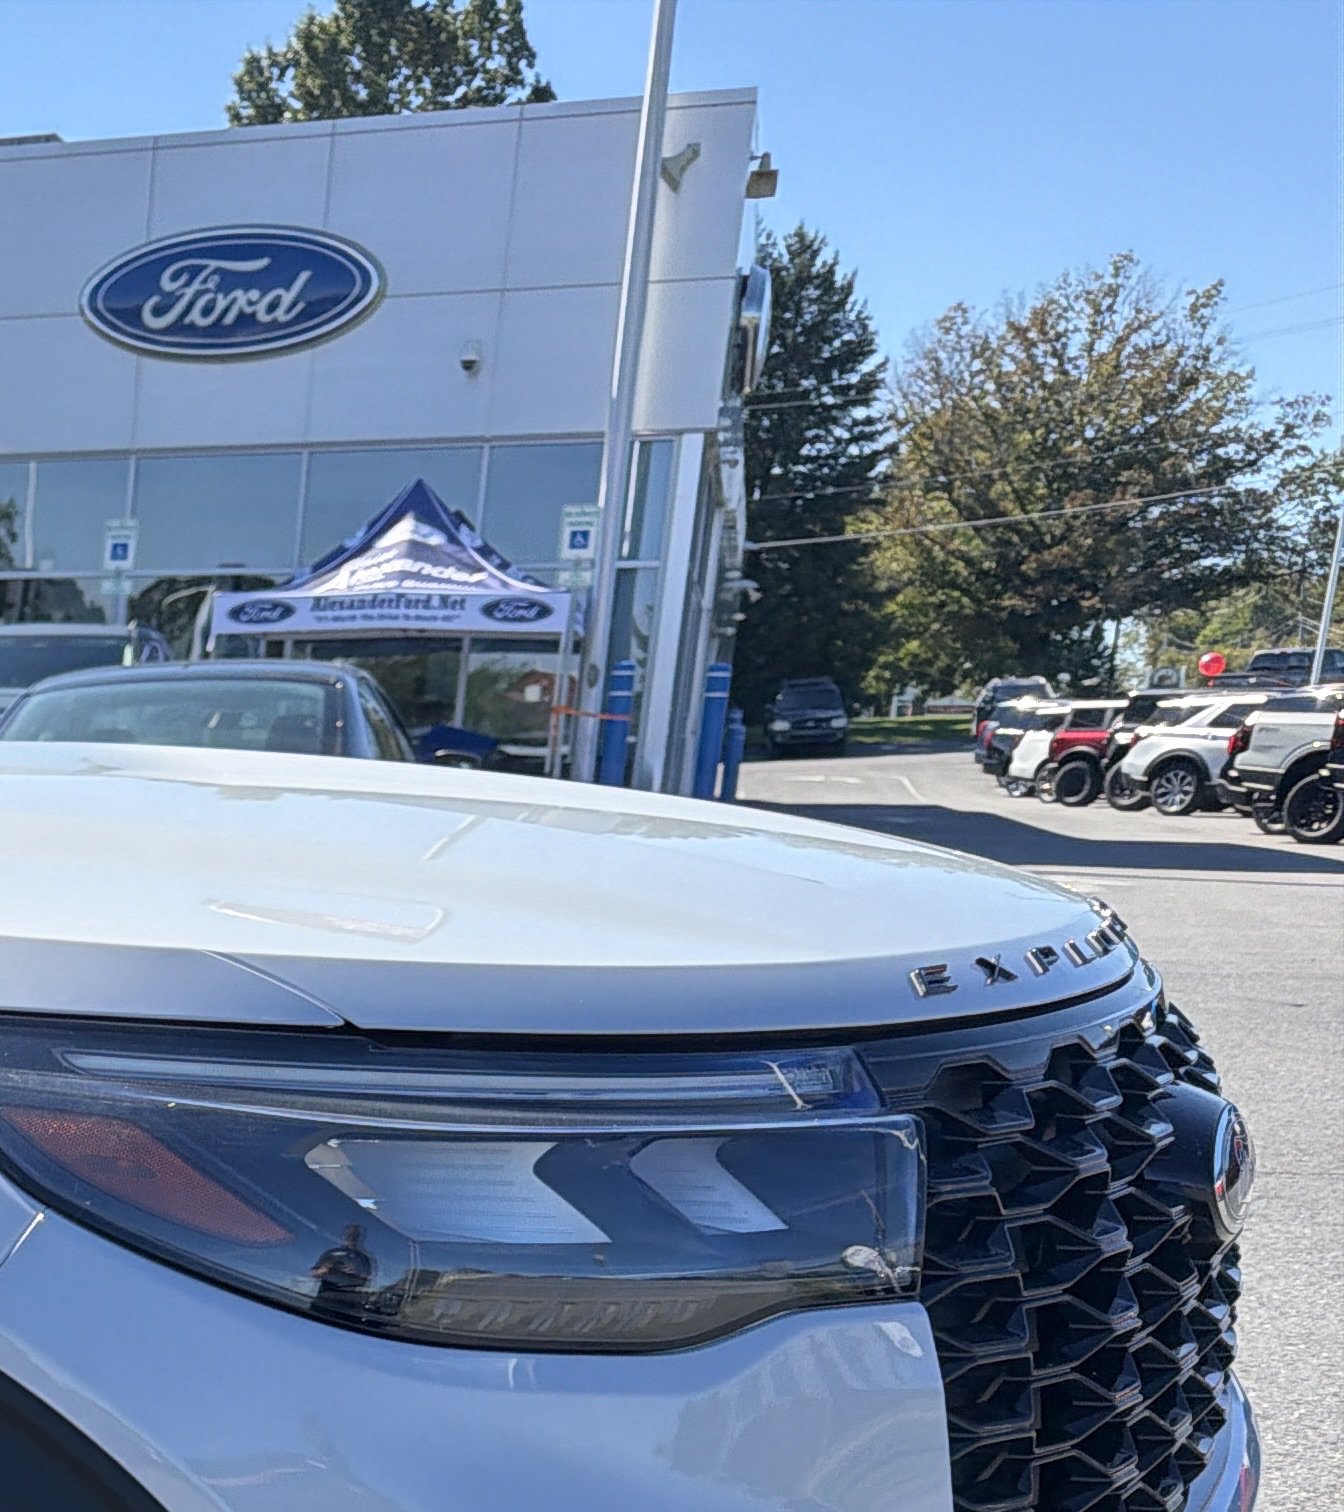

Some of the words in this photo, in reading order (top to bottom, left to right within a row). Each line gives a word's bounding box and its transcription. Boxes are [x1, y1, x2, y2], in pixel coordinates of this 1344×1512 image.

[141, 256, 313, 331] Ford
[238, 602, 285, 622] Ford
[492, 600, 541, 619] Ford
[908, 896, 1128, 998] EXPLO
